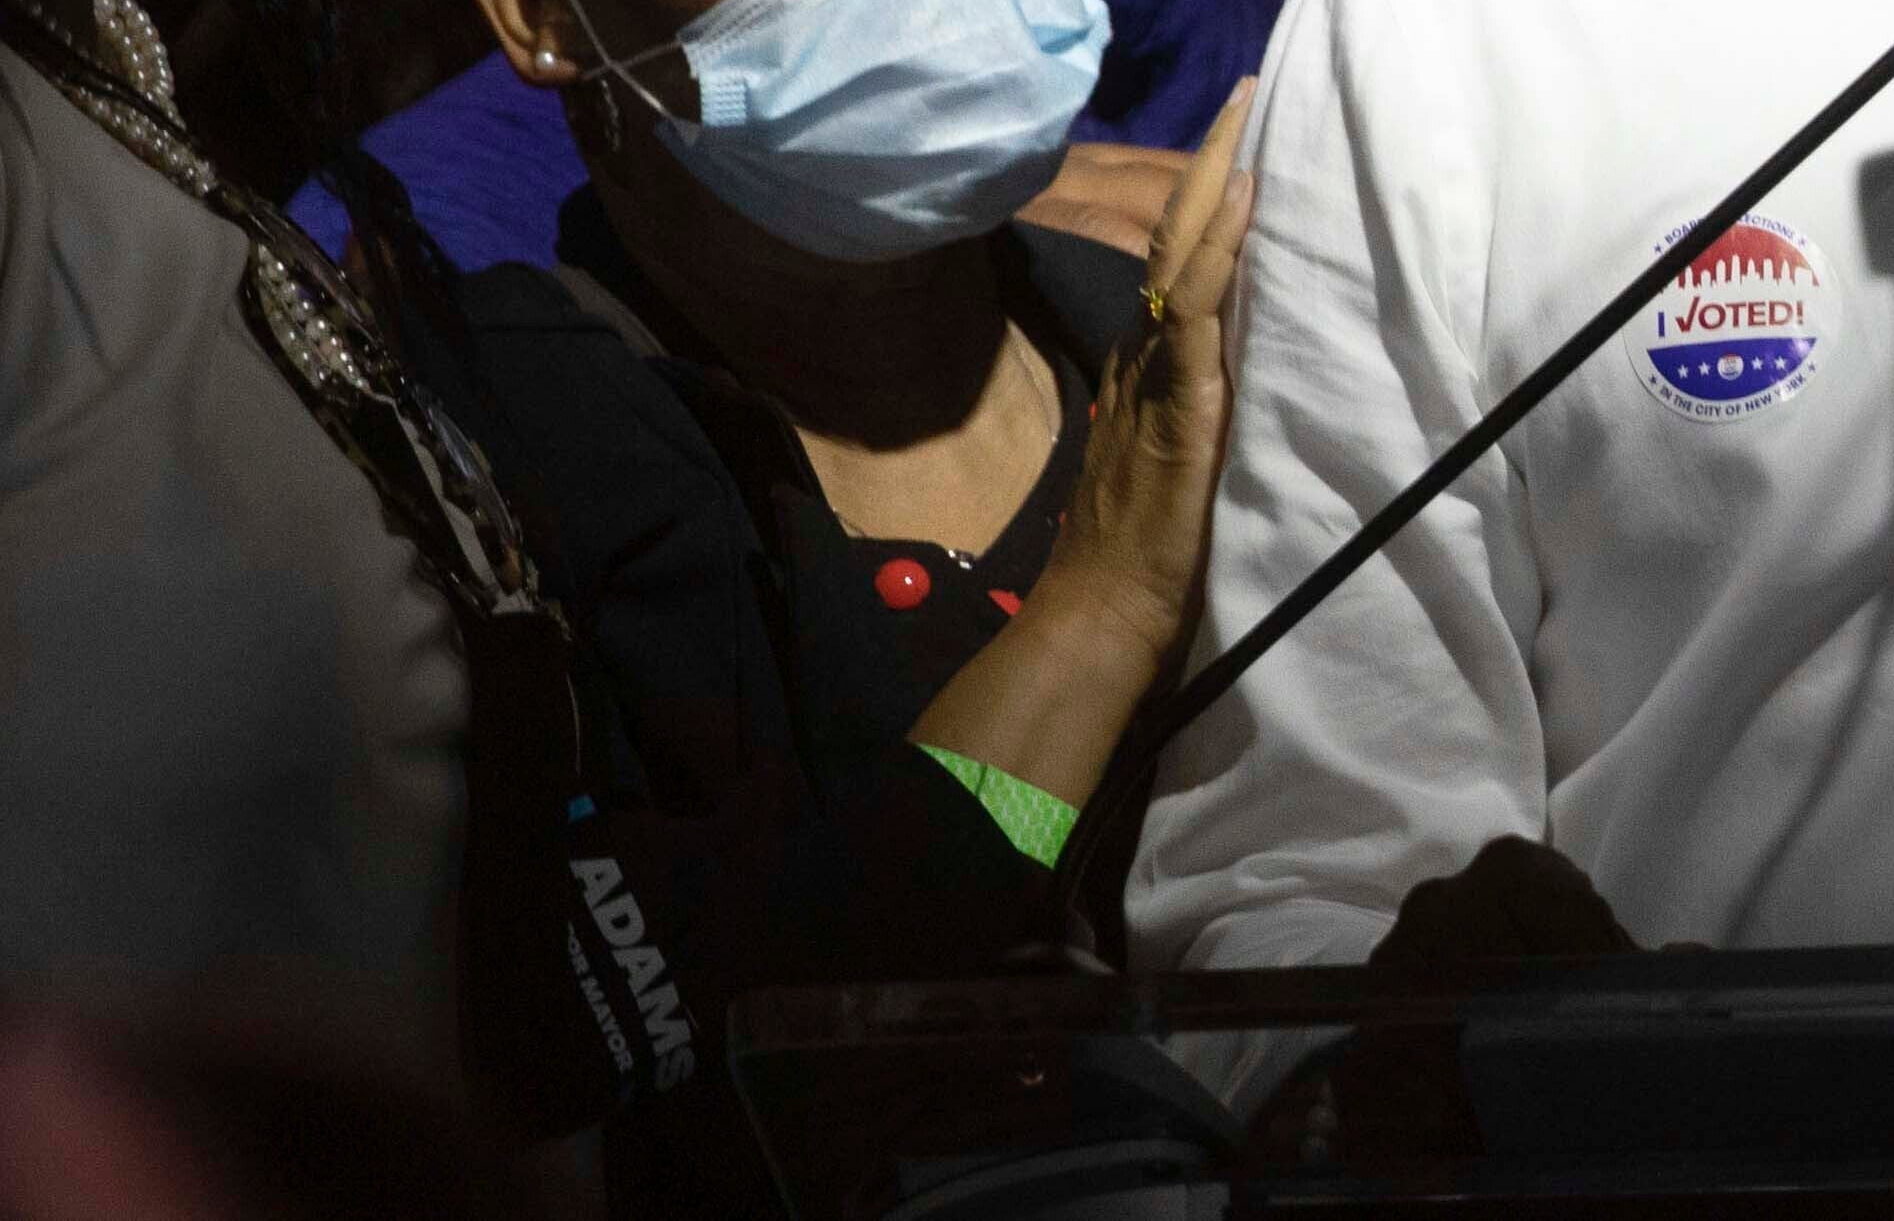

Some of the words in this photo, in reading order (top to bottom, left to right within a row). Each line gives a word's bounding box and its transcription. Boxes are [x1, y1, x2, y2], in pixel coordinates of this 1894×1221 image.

[1664, 218, 1702, 244] BOAR
[1740, 213, 1796, 238] ECTIONS
[1658, 312, 1665, 337] I
[1675, 296, 1803, 333] VOTED!
[1659, 385, 1673, 400] IN
[1674, 393, 1692, 411] THE
[1695, 403, 1722, 417] CITY
[1725, 403, 1741, 416] OF
[1745, 394, 1772, 412] NEW
[569, 857, 695, 1092] ADAMS
[579, 974, 634, 1073] MAYOR
